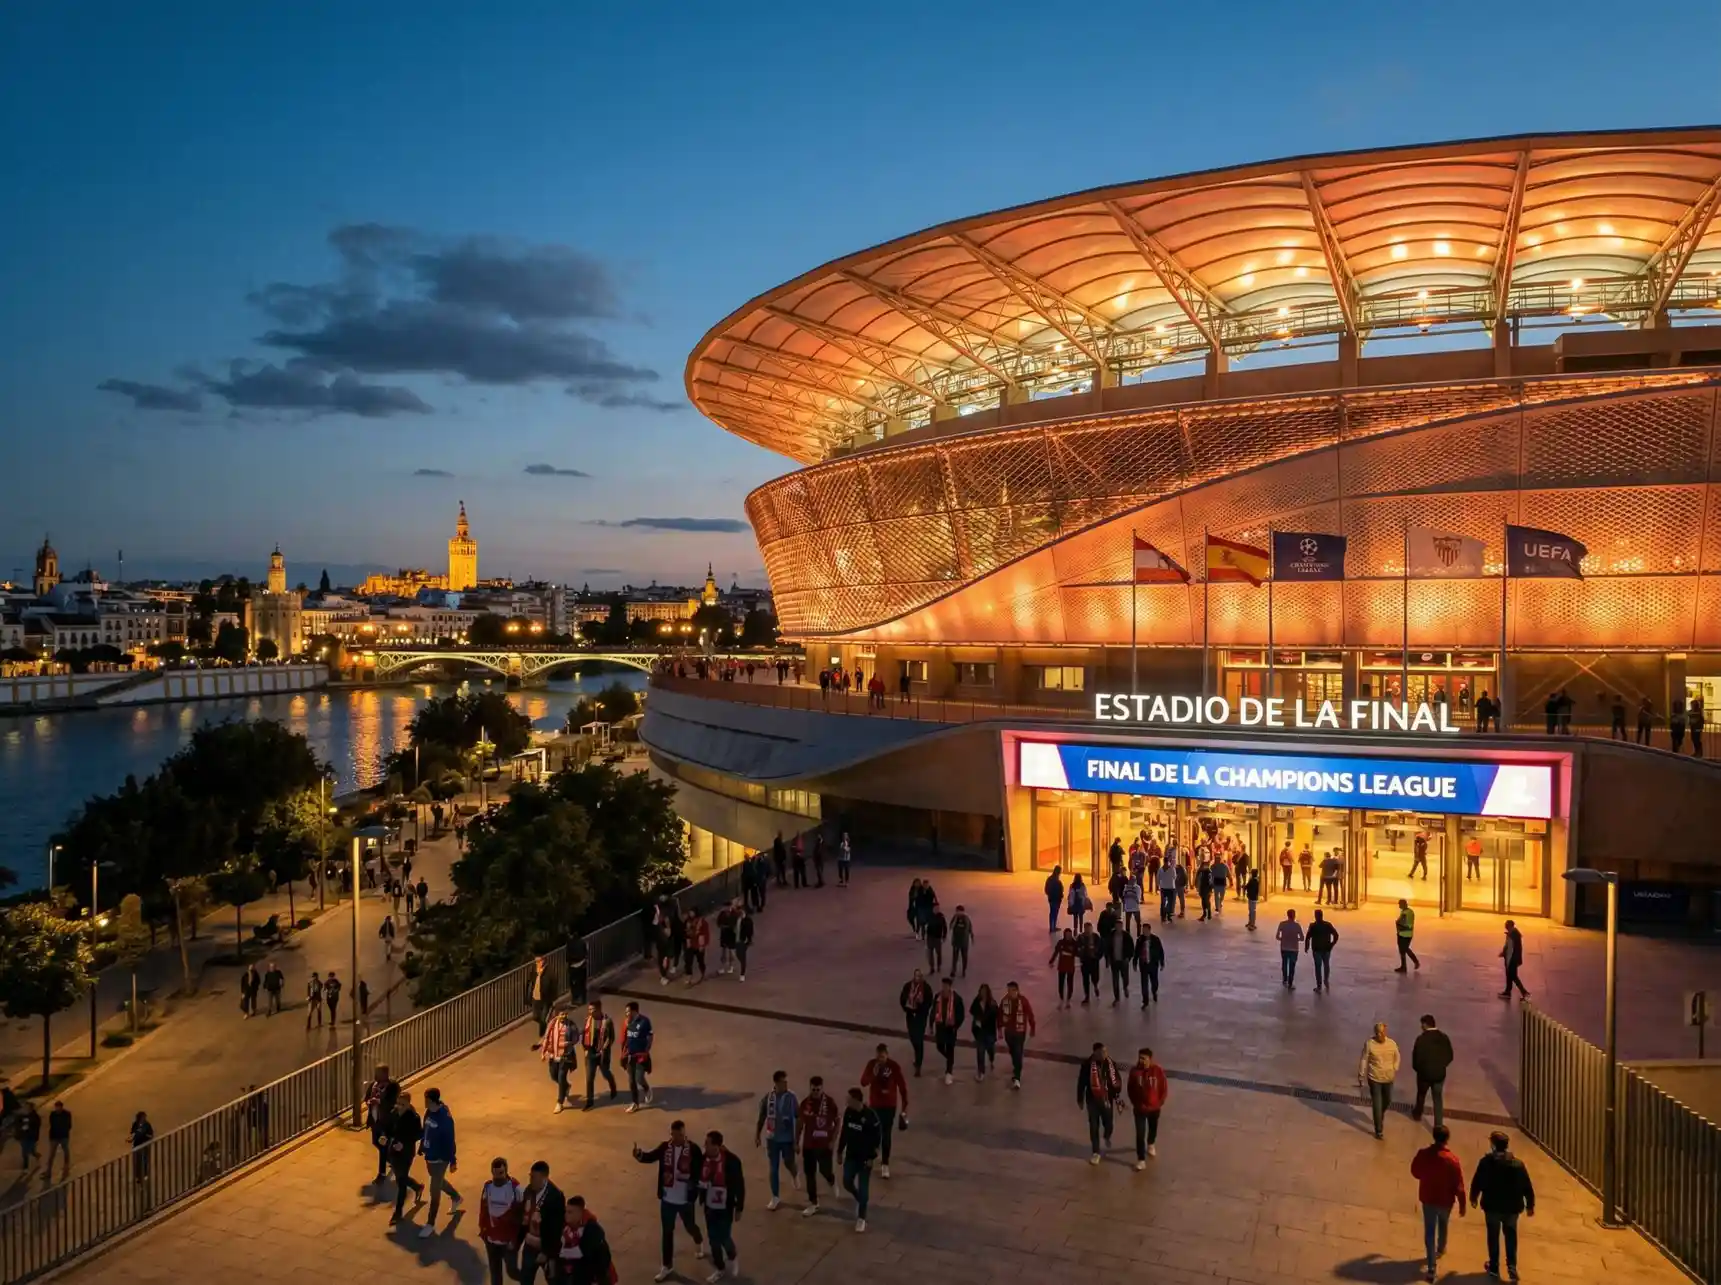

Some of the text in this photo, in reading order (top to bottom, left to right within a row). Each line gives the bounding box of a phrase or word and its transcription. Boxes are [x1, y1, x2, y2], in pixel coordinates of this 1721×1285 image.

[1524, 543, 1572, 562] UEFA
[1095, 693, 1461, 732] ESTADIO DE LA FINAL
[1087, 759, 1457, 798] FINAL DE LA CHAMPIONS LEAGUE
